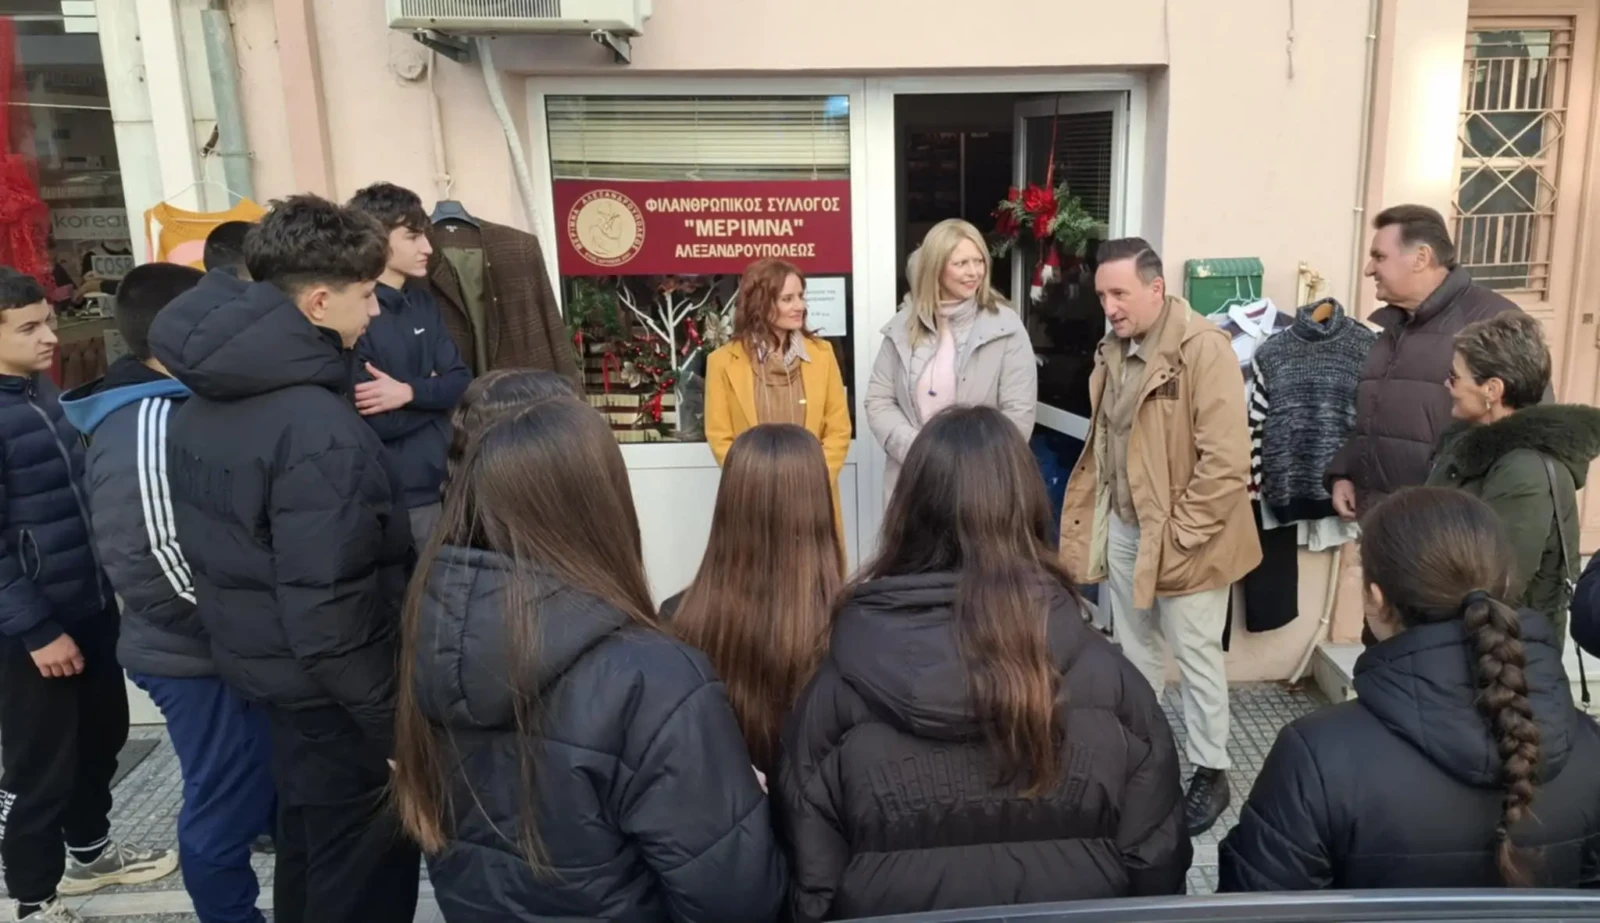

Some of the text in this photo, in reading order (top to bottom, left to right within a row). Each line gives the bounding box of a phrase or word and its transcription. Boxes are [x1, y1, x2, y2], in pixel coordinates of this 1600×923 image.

[645, 197, 840, 213] ΦΙΛΑΝΘΡΩΠΙΚΟΣ ΣΥΛΛΟΓΟΣ
[684, 219, 804, 237] "ΜΕΡΙΜΝΑ"
[675, 243, 816, 258] ΑΛΕΞΑΝΔΡΟΥΠΟΛΕΩΣ
